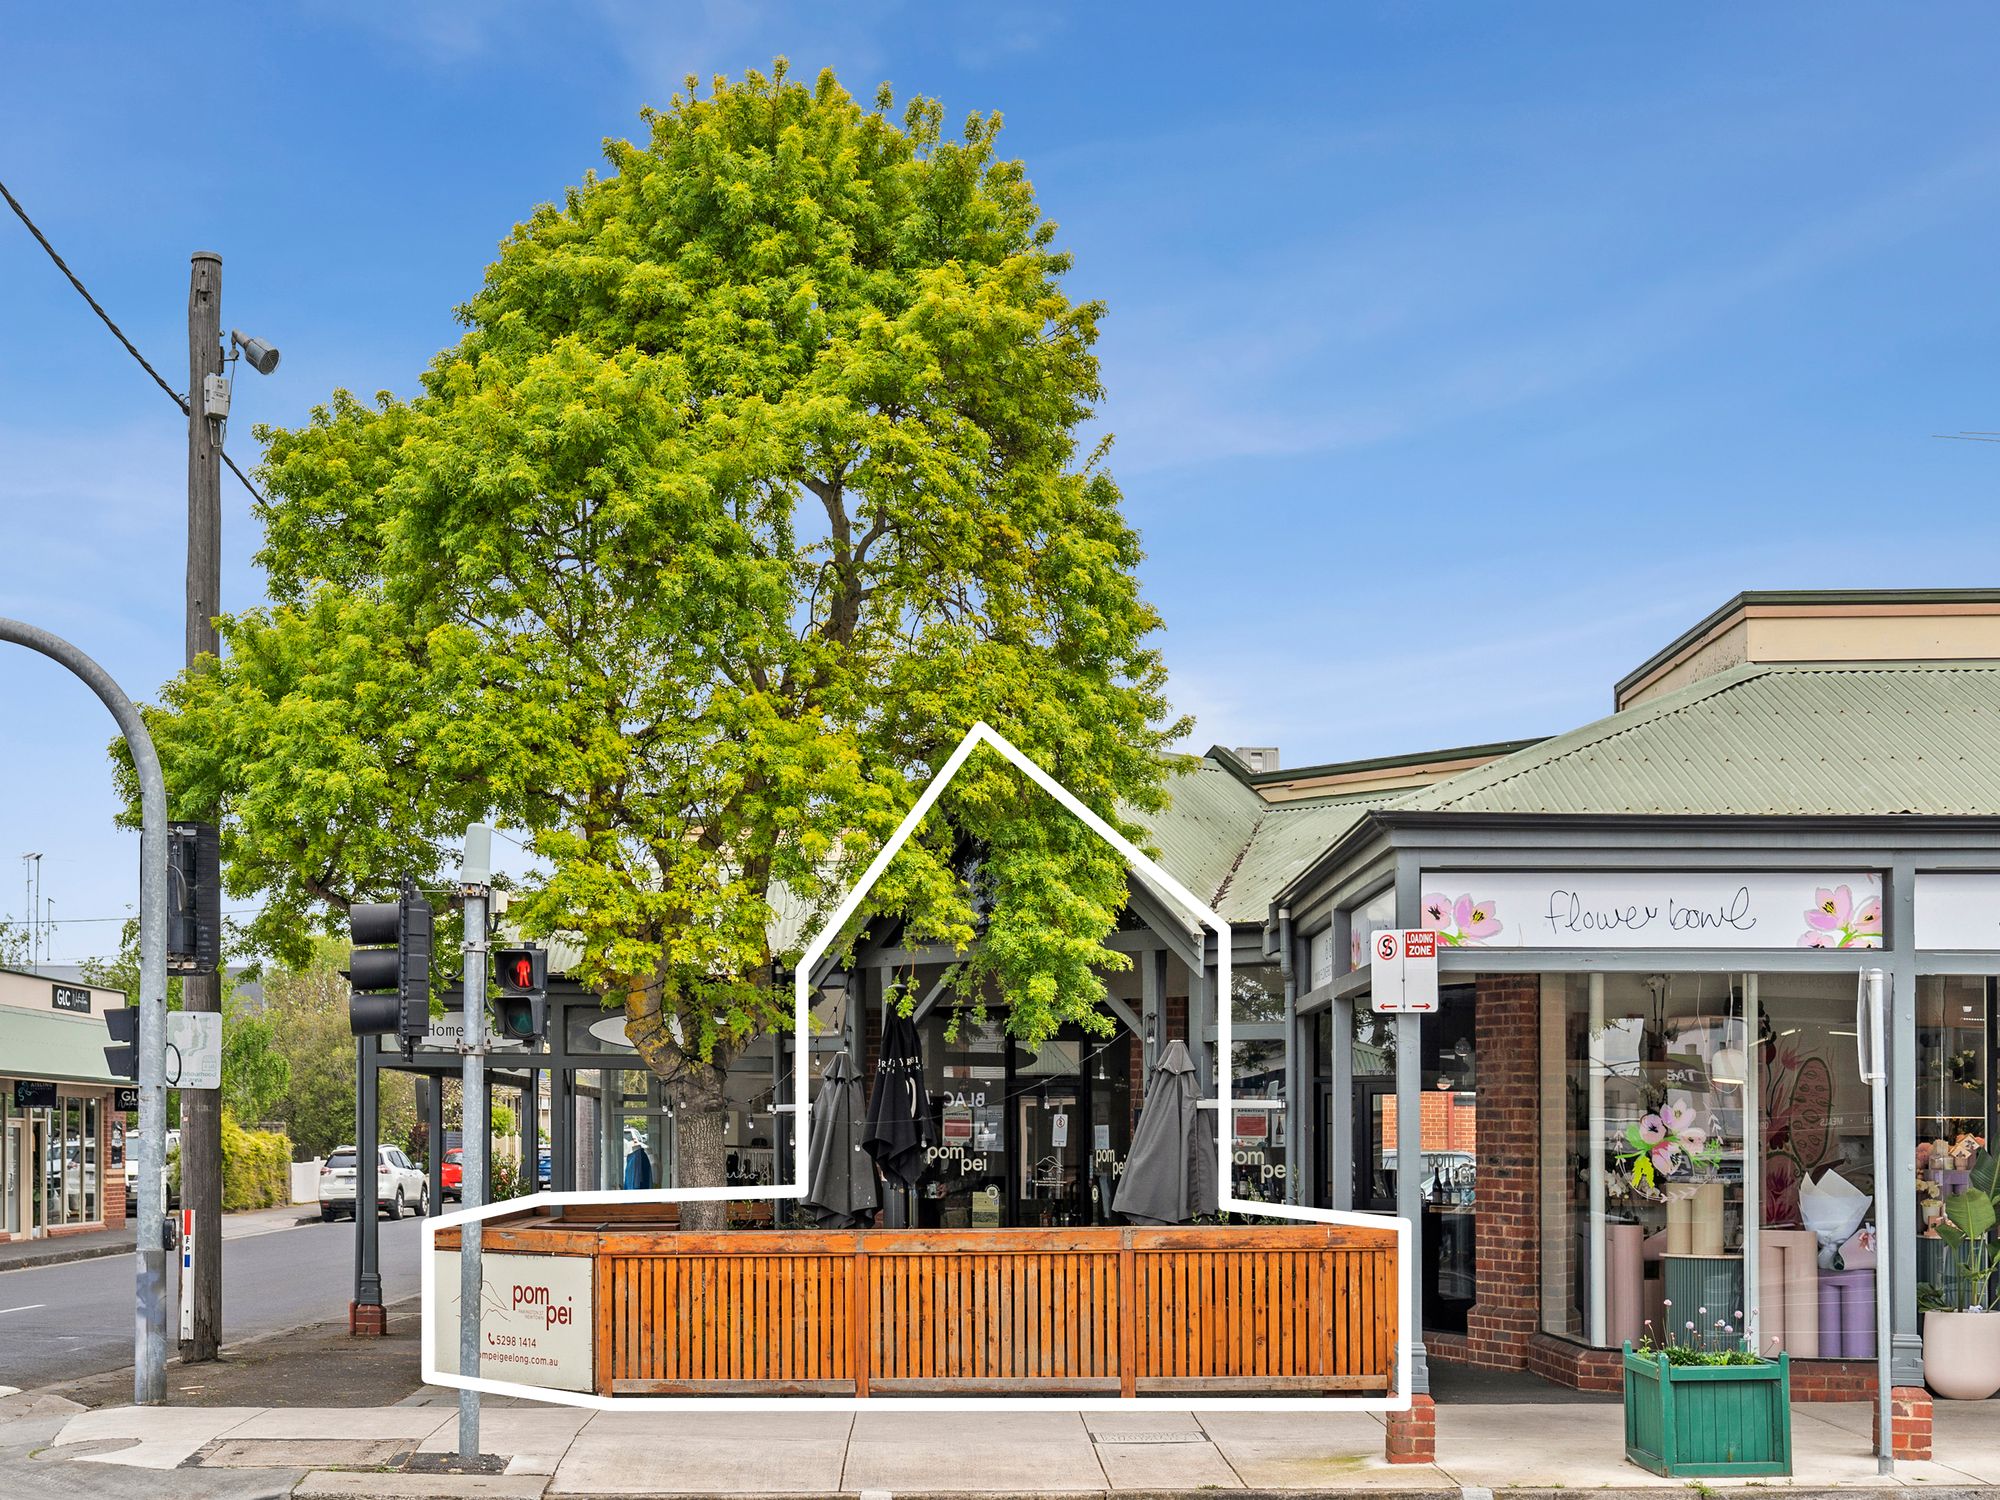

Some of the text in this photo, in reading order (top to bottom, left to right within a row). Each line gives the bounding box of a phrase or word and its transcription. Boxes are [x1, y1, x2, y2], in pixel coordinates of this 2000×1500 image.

[1545, 886, 1757, 935] flower bowl
[1406, 933, 1433, 943] LOADING
[1408, 945, 1432, 955] ZONE
[56, 988, 71, 1007] GLC
[121, 1090, 139, 1101] GL
[927, 1146, 965, 1165] pom
[961, 1152, 987, 1176] pei
[1095, 1149, 1115, 1168] pom
[1231, 1150, 1265, 1166] om
[1260, 1163, 1287, 1184] pe
[512, 1284, 550, 1311] pom
[546, 1296, 572, 1331] pei
[496, 1334, 537, 1348] 5298 1414
